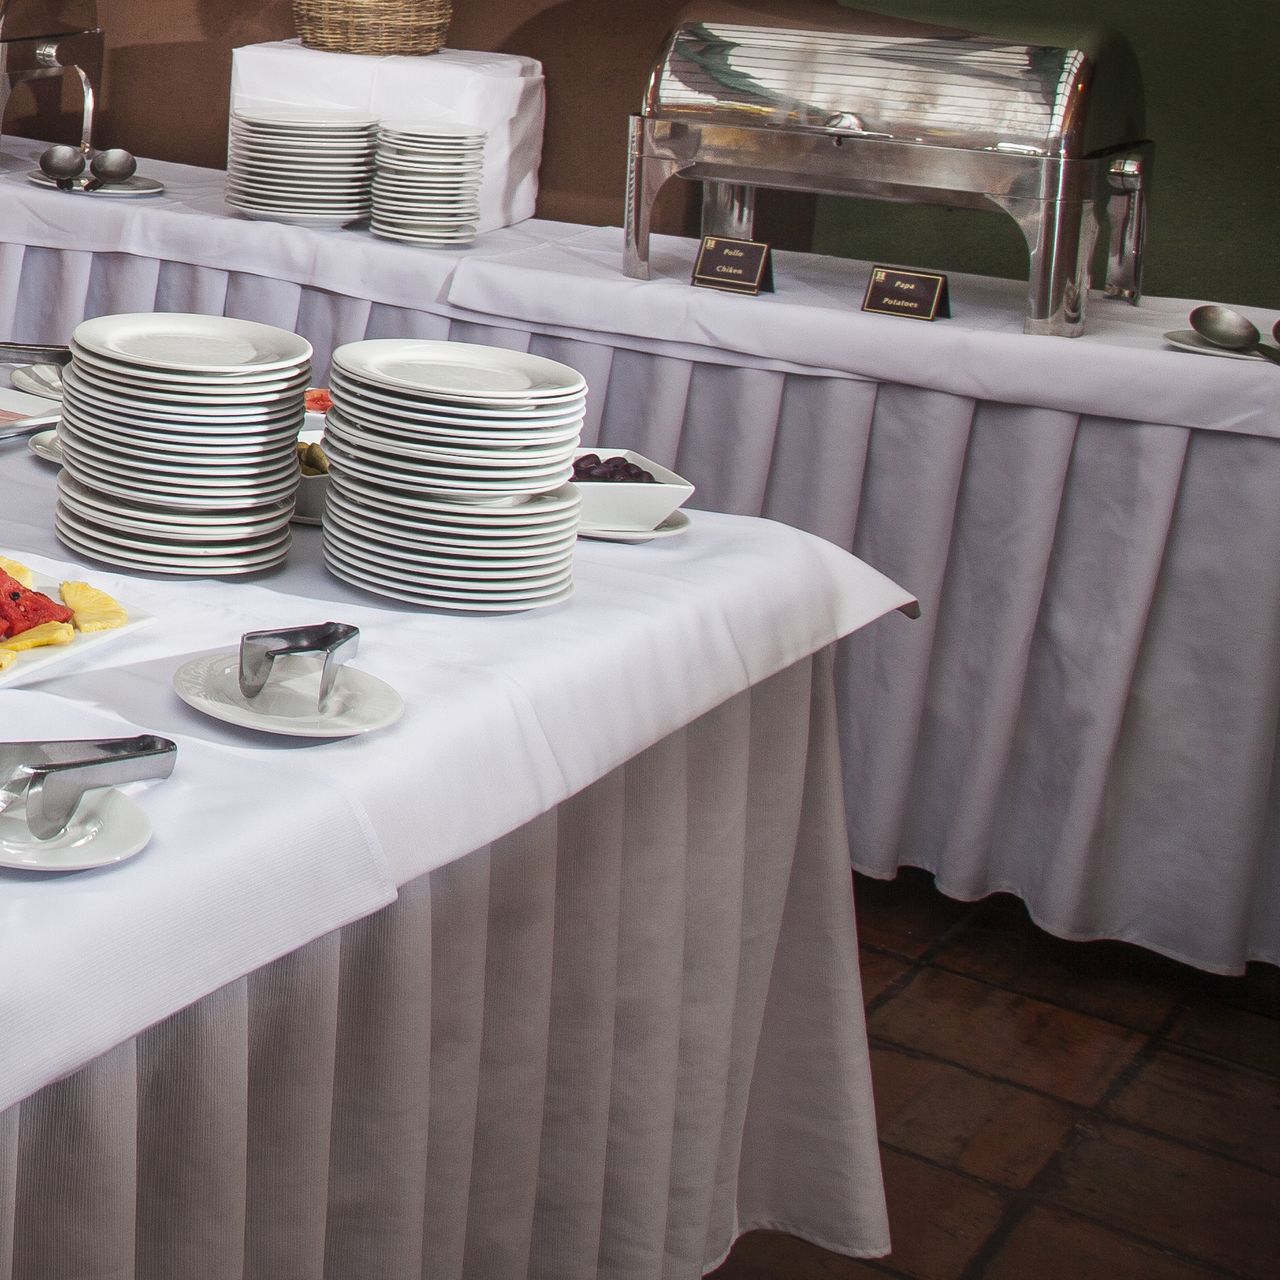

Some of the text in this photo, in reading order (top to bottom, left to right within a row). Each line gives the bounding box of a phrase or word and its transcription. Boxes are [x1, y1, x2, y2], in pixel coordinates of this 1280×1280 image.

[723, 248, 744, 257] Pollo
[894, 280, 916, 290] Papa
[882, 297, 919, 308] Potatoes
